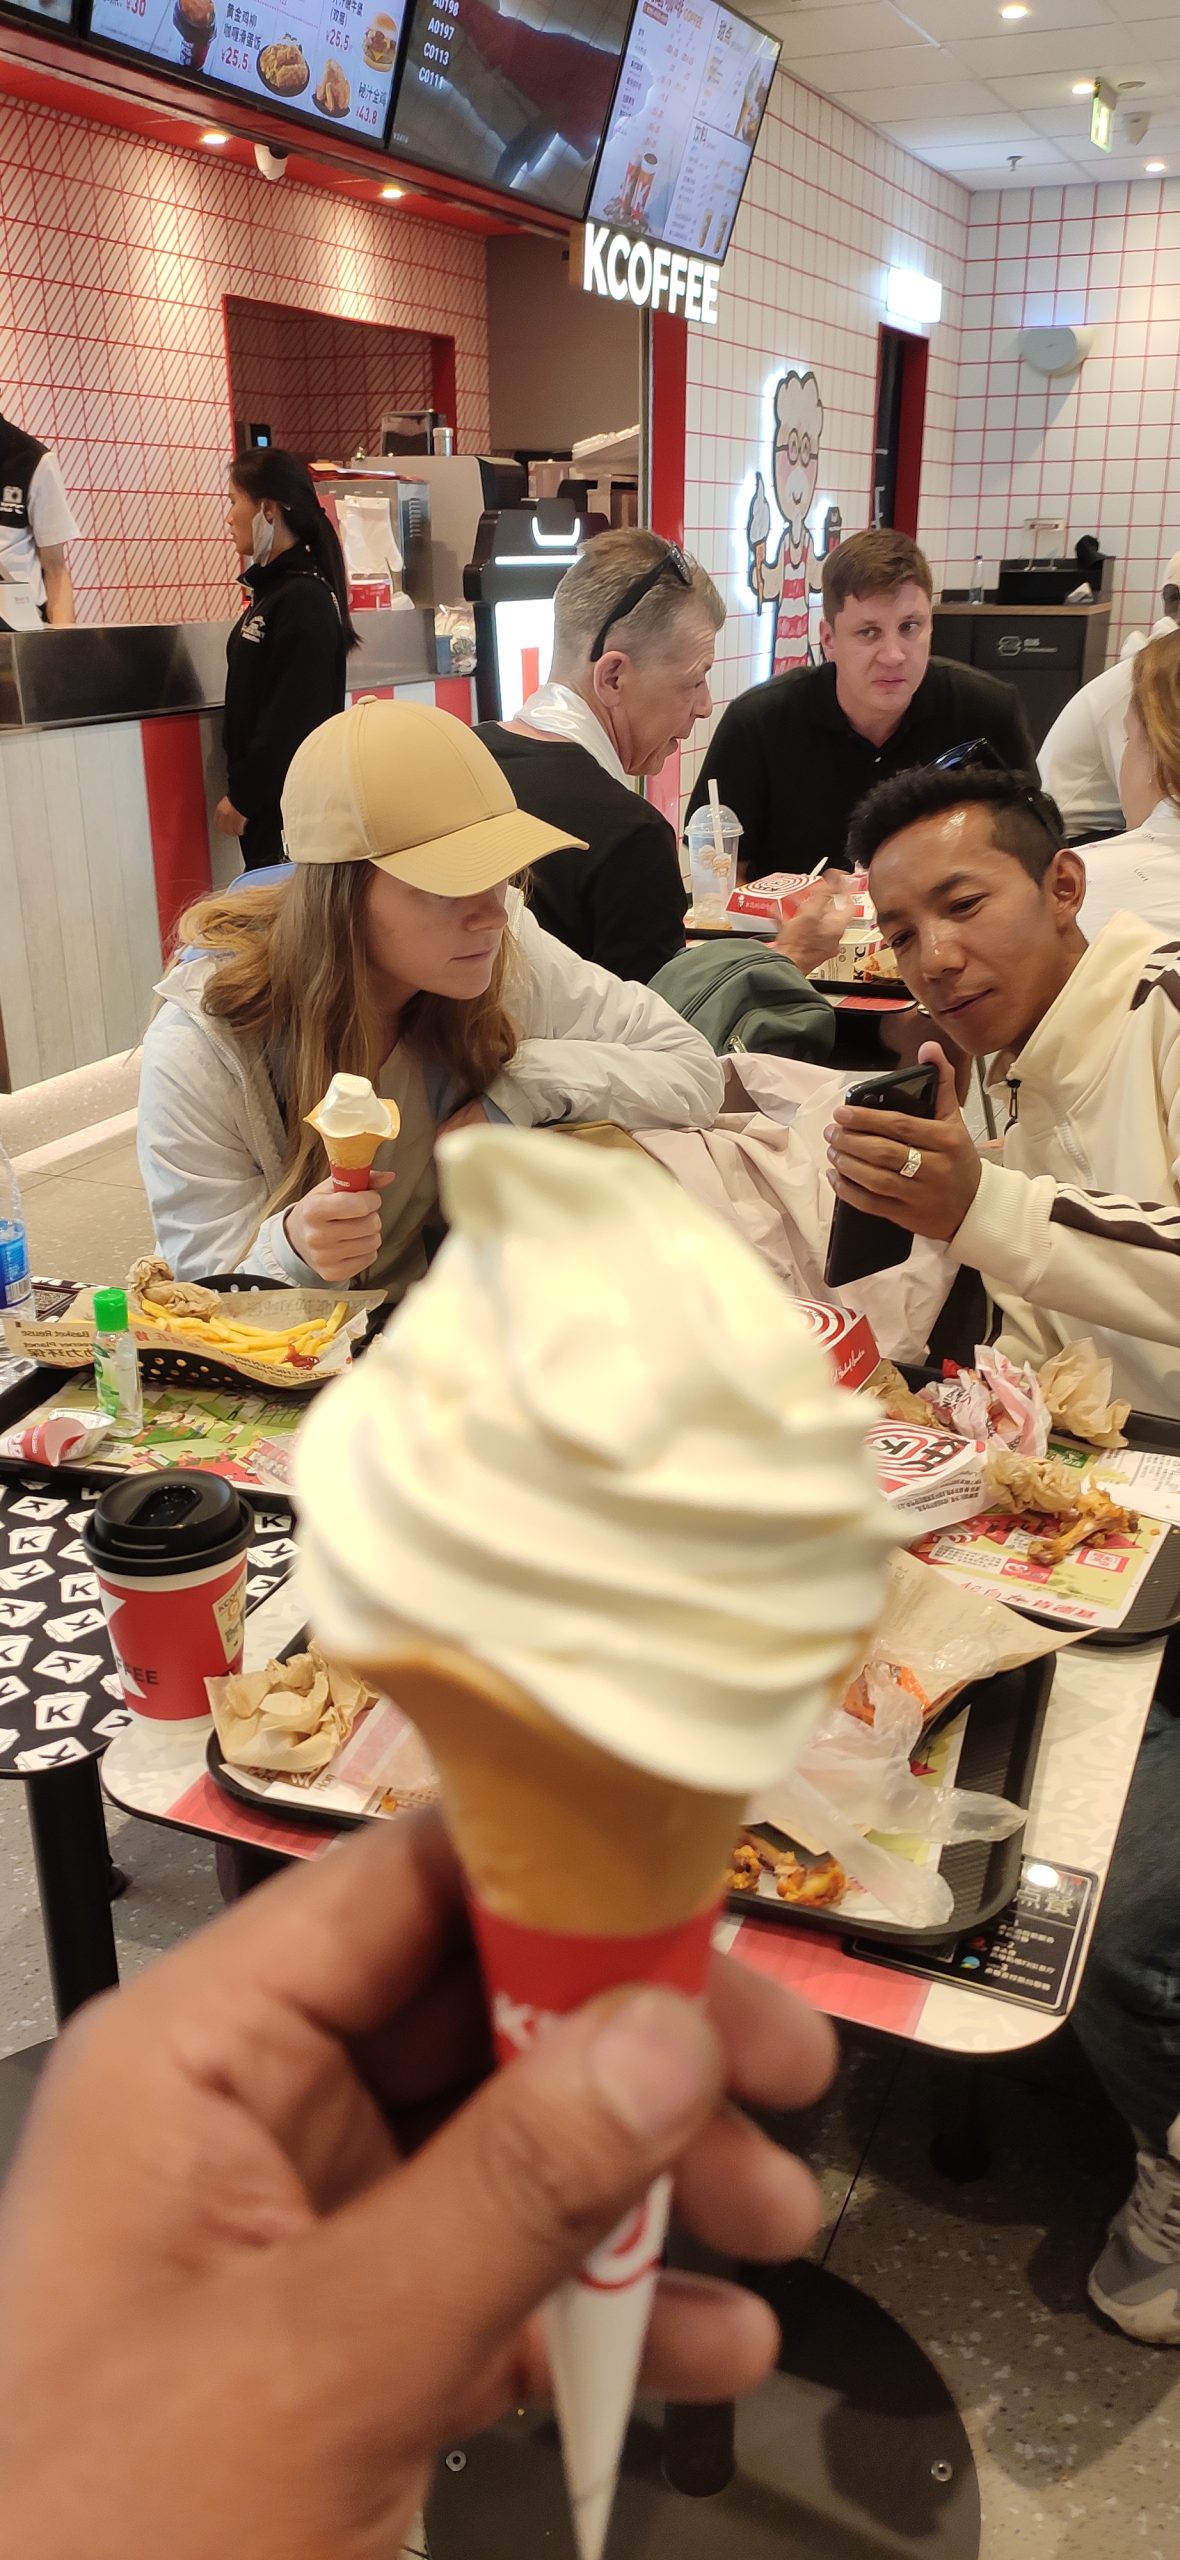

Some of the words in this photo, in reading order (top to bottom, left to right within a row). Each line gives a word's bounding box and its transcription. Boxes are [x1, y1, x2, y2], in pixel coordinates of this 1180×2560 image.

[427, 17, 455, 41] A0197
[423, 42, 449, 65] C0113
[418, 66, 444, 89] C0111
[583, 221, 721, 325] KCOFFEE
[853, 945, 867, 981] KC
[17, 1500, 48, 1513] K
[262, 1514, 286, 1529] K
[16, 1535, 44, 1549] K
[261, 1543, 294, 1559] K
[11, 1565, 44, 1580] K
[69, 1582, 96, 1597] K
[63, 1613, 99, 1631] K
[44, 1656, 82, 1673] K
[45, 1703, 75, 1723] K
[38, 1744, 77, 1766] K
